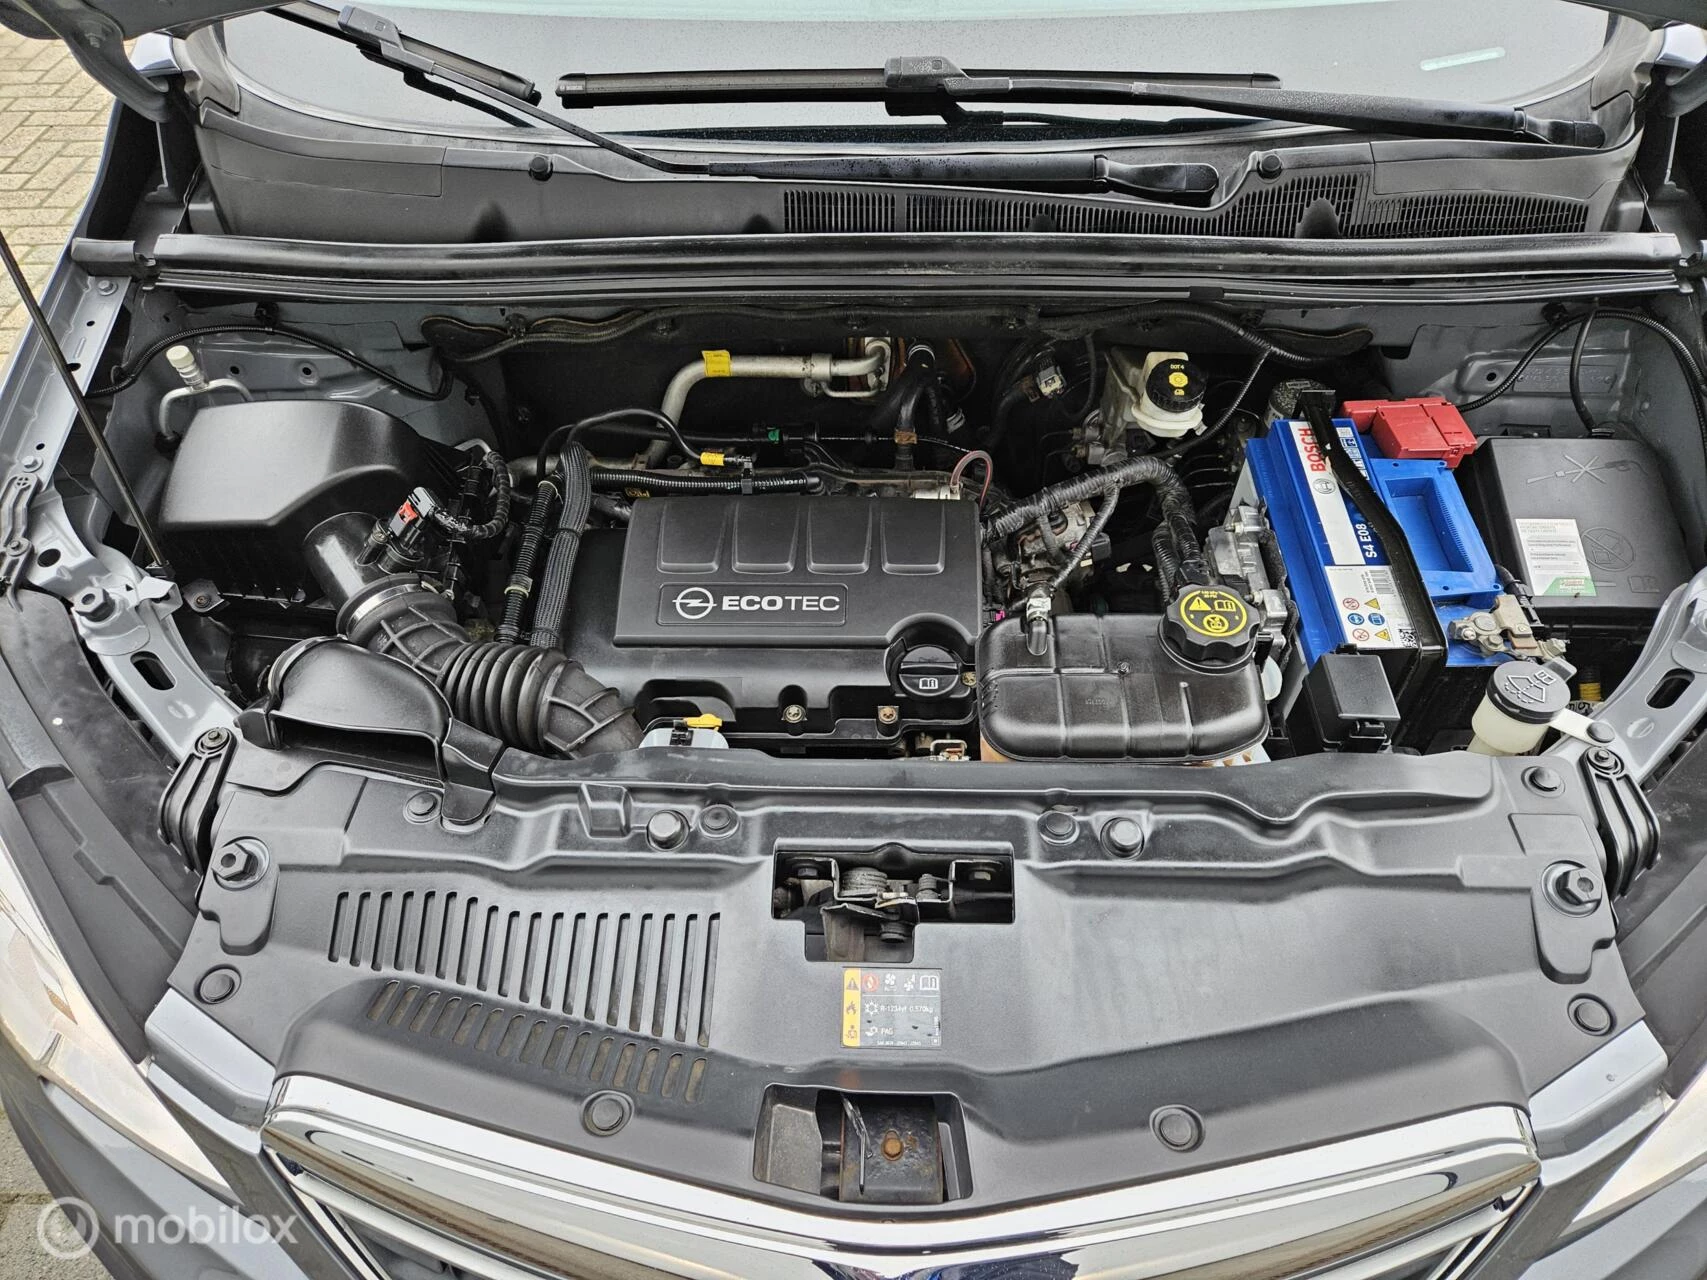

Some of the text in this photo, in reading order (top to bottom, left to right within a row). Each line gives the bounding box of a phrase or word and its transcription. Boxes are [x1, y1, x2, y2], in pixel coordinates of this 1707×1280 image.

[1298, 427, 1326, 472] BOSCH
[1355, 523, 1372, 542] E08
[1362, 544, 1378, 558] S4
[721, 595, 841, 612] ECOTEC
[880, 1027, 894, 1036] PAG
